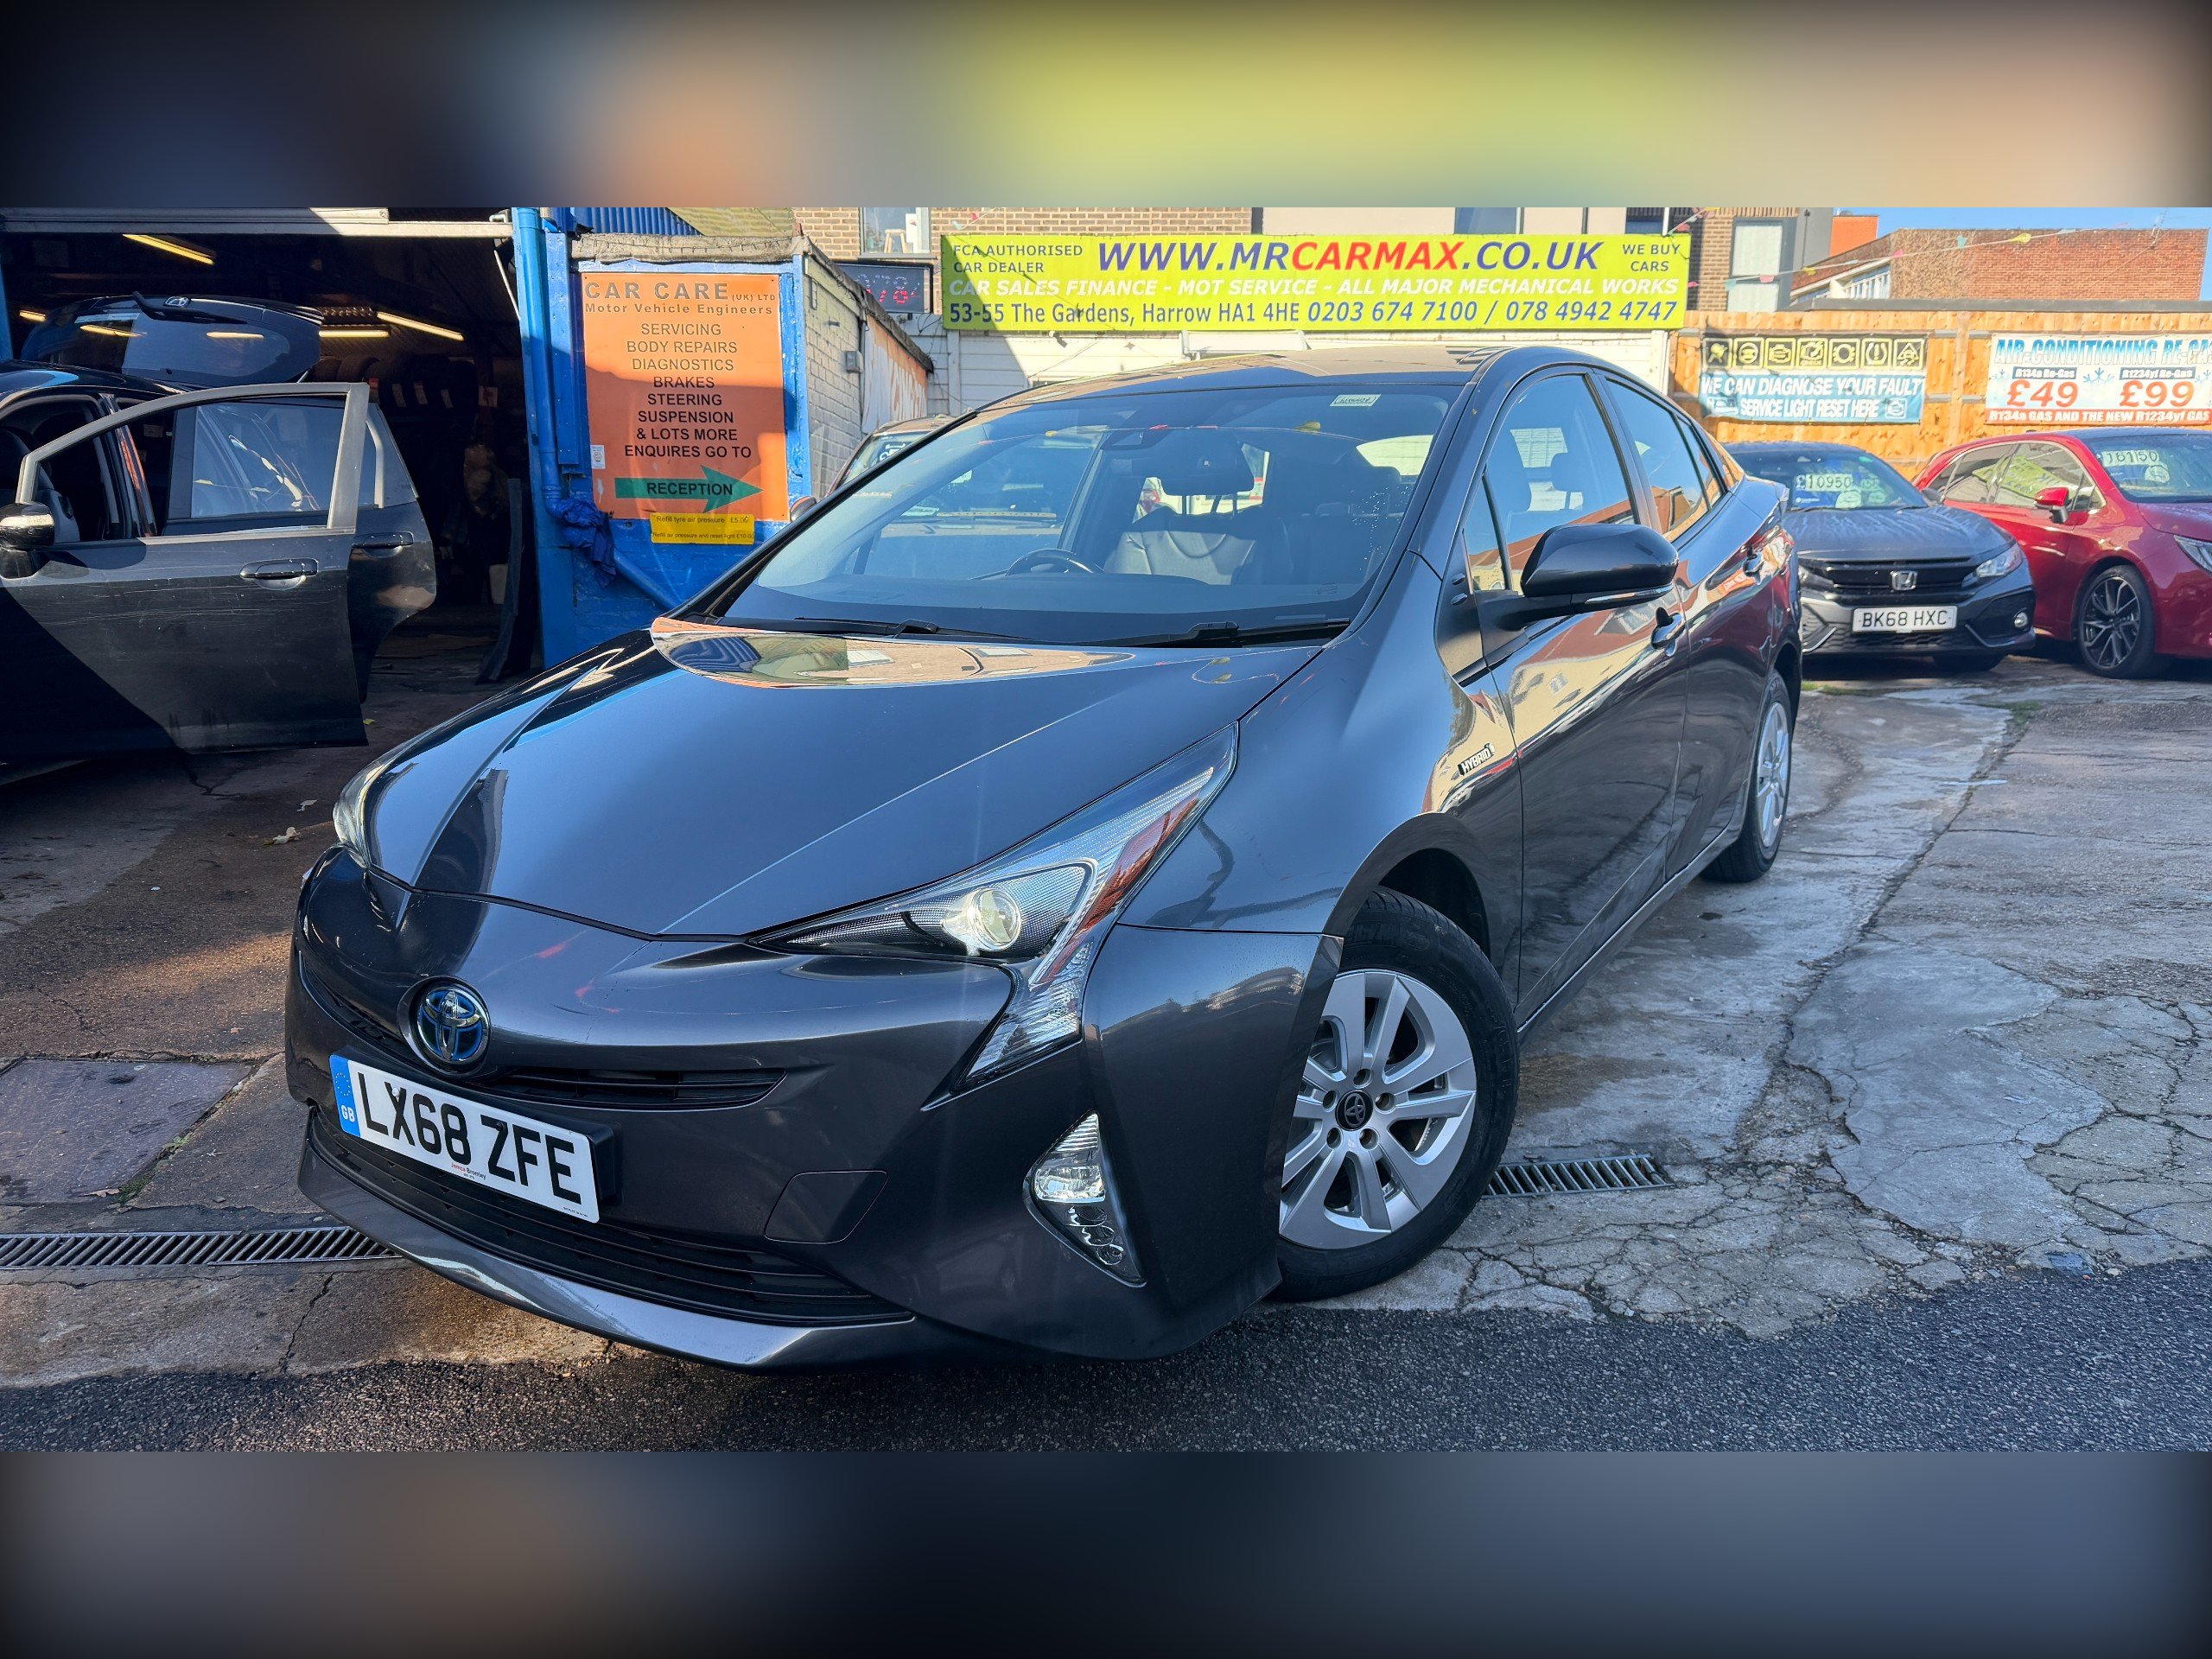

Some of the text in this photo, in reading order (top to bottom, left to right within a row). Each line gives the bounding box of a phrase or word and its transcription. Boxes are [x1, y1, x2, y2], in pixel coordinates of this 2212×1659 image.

[953, 245, 1083, 257] FCA AUTHORISED
[1098, 241, 1605, 271] WWW.MRCARMAX.CO.UK
[1623, 244, 1681, 256] WE BUY
[953, 262, 1045, 273] CAR DEALER
[1630, 260, 1669, 272] CARS
[584, 282, 641, 300] CAR
[654, 283, 728, 300] CARE
[732, 294, 753, 302] (UK)
[950, 280, 991, 296] CAR
[996, 279, 1060, 296] SALES
[1066, 279, 1157, 296] FINANCE
[1178, 279, 1222, 296] MOT
[1229, 278, 1317, 296] SERVICE
[1337, 279, 1376, 295] ALL
[1382, 278, 1452, 295] MAJOR
[1459, 278, 1594, 295] MECHANICAL
[1601, 278, 1679, 295] WORKS
[585, 303, 772, 316] Motor Vehicle Engineers
[950, 302, 1005, 323] 53-55
[1011, 302, 1046, 323] The
[1052, 302, 1135, 327] Gardens,
[1142, 302, 1211, 323] Harrow
[1218, 302, 1255, 323] HA1
[1263, 302, 1300, 322] 4HE
[1307, 302, 1363, 322] 0203
[1371, 302, 1414, 322] 674
[1421, 301, 1478, 321] 7100
[1506, 301, 1548, 321] 078
[1554, 301, 1611, 321] 4942
[1618, 301, 1677, 321] 4747
[641, 323, 721, 336] SERVICING
[626, 341, 737, 353] BODY REPAIRS
[632, 359, 734, 372] DIAGNOSTICS
[653, 376, 715, 388] BRAKES
[1701, 376, 1922, 396] WE CAN DIAGNOSE YOUR FAULT
[647, 393, 722, 406] STEERING
[2006, 378, 2079, 408] £49
[2119, 379, 2195, 408] £99
[1740, 398, 1878, 418] SERVICE LIGHT RESET HERE
[638, 410, 734, 423] SUSPENSION
[1989, 410, 2027, 422] R134a
[2029, 410, 2053, 422] GAS
[2055, 410, 2079, 422] AND
[2082, 410, 2104, 422] THE
[2106, 410, 2133, 422] NEW
[2187, 410, 2211, 421] GAS
[636, 428, 737, 441] & LOTS MORE
[625, 445, 752, 458] ENQUIRES GO TO
[646, 482, 733, 496] RECEPTION
[1862, 610, 1948, 628] BK68 HXC
[1460, 747, 1491, 774] HYBRID
[340, 1104, 355, 1122] GB
[357, 1072, 582, 1205] LX68 ZFE
